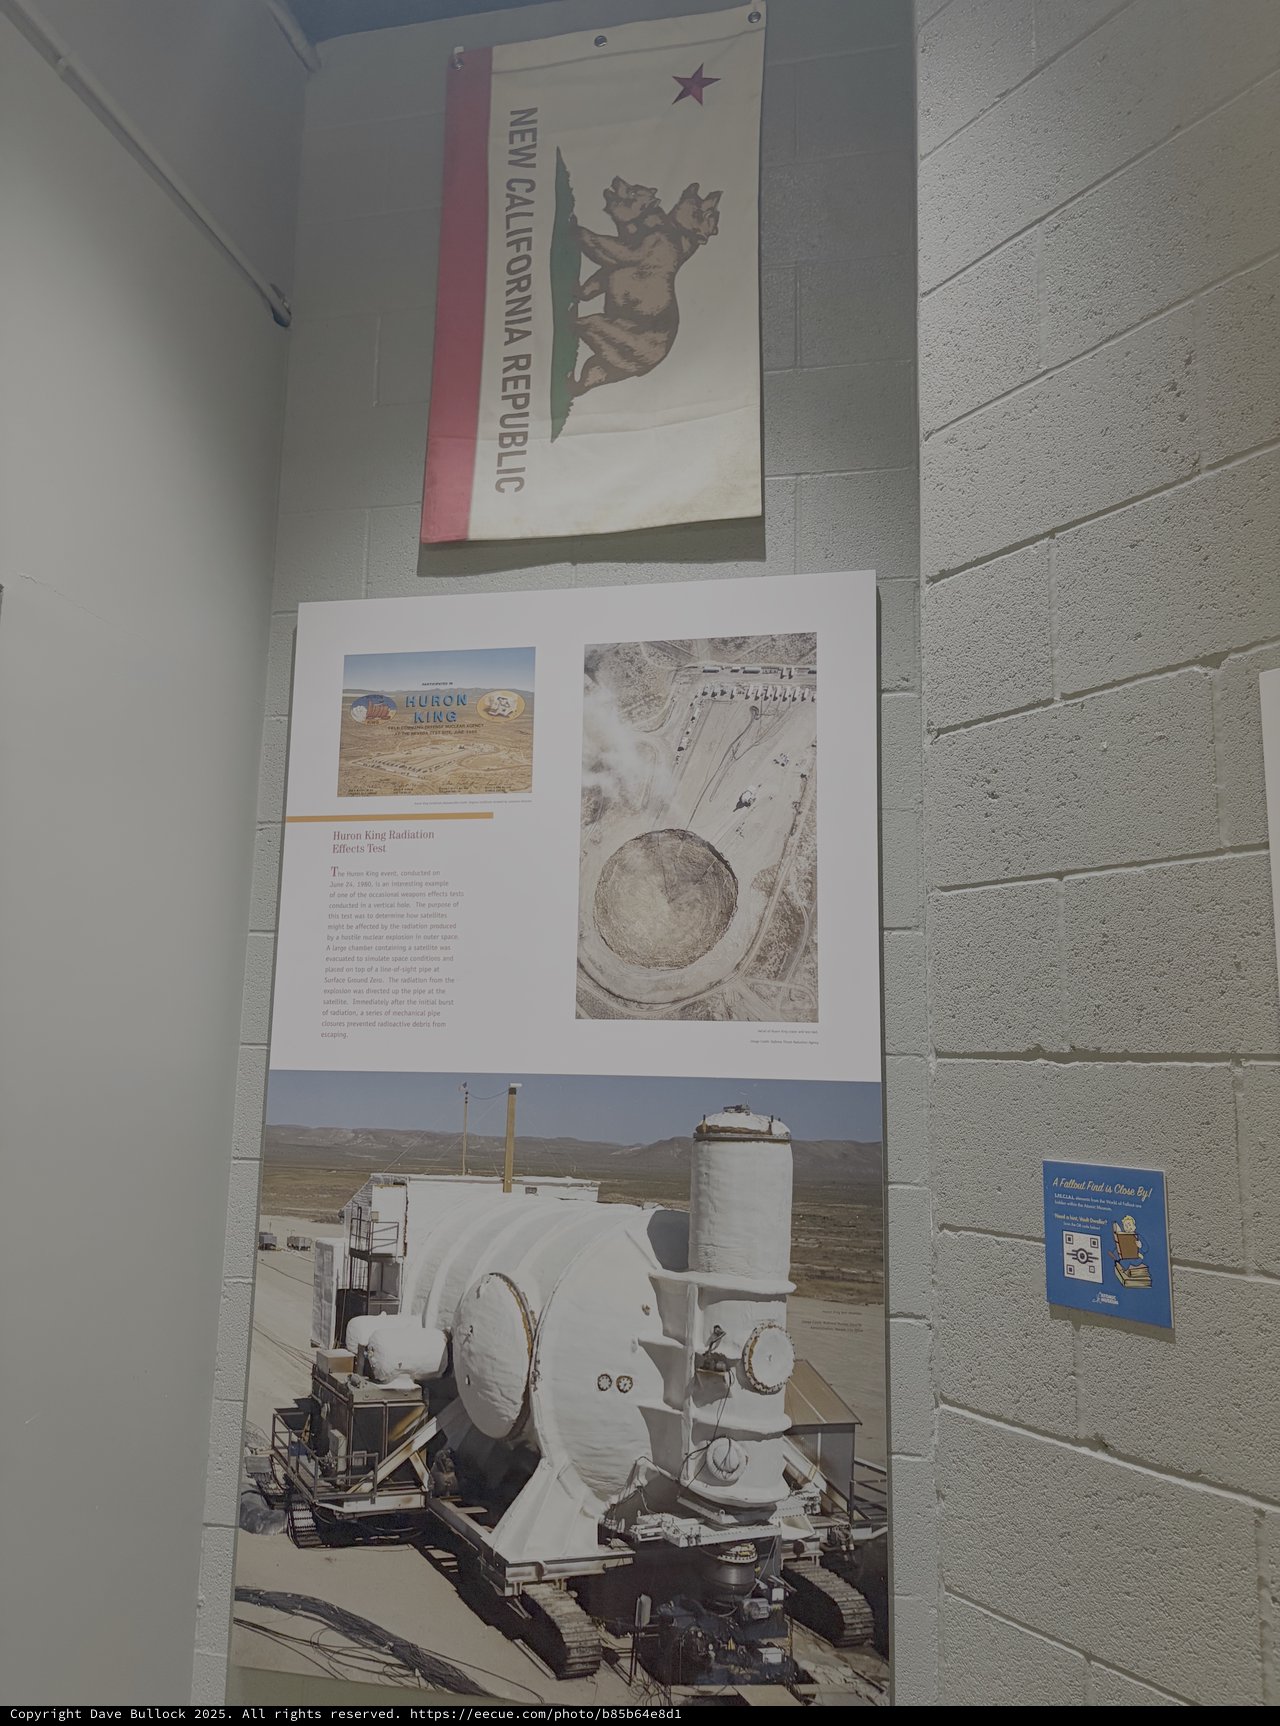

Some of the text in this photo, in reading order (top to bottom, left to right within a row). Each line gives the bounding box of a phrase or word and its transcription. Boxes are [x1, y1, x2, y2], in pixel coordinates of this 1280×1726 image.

[494, 107, 538, 493] NEW CALIFORNIA REPUBLIC
[405, 693, 468, 707] HURON
[414, 711, 457, 723] KING
[364, 830, 386, 843] King
[388, 829, 434, 840] Radiation
[332, 843, 385, 854] Effects Test
[331, 866, 346, 877] The
[365, 869, 378, 879] King
[400, 868, 431, 876] conducted
[329, 880, 344, 888] June
[375, 879, 380, 887] is
[391, 879, 423, 889] interesting
[424, 879, 448, 889] example
[329, 890, 335, 898] of
[368, 889, 399, 897] occasional
[400, 891, 426, 899] weapons
[427, 889, 447, 897] effects
[328, 901, 358, 909] conducted
[360, 900, 366, 908] in
[373, 900, 395, 908] vertical
[415, 900, 426, 908] The
[427, 902, 451, 910] purpose
[328, 911, 339, 919] this
[374, 911, 404, 919] determine
[420, 910, 447, 918] satellites
[327, 922, 344, 932] might
[346, 922, 353, 930] be
[380, 921, 388, 931] by
[389, 921, 399, 929] the
[401, 921, 427, 929] radiation
[429, 921, 456, 931] produced
[326, 933, 334, 942] by
[362, 932, 384, 940] nuclear
[385, 932, 413, 942] explosion
[415, 932, 421, 940] in
[332, 943, 346, 953] large
[347, 943, 372, 951] chamber
[374, 943, 406, 953] containing
[413, 943, 438, 951] satellite
[325, 954, 355, 962] evacuated
[356, 954, 363, 962] to
[324, 965, 344, 974] placed
[354, 965, 365, 974] top
[380, 965, 416, 974] line-of-sight
[418, 965, 431, 974] pipe
[323, 975, 454, 983] Surface Ground Zero. The radiation from the
[323, 986, 351, 996] explosion
[365, 986, 389, 994] directed
[391, 988, 399, 996] up
[400, 986, 411, 994] the
[412, 986, 425, 996] pipe
[435, 986, 445, 994] the
[323, 997, 453, 1007] satellite. Immediately after the initial burst
[329, 1008, 358, 1017] radiation,
[365, 1008, 382, 1016] series
[383, 1008, 390, 1016] of
[392, 1008, 425, 1016] mechanical
[427, 1008, 440, 1018] pipe
[321, 1019, 446, 1029] closures prevented radioactive debris from
[1053, 1178, 1152, 1201] A Fallout Find is Close By!
